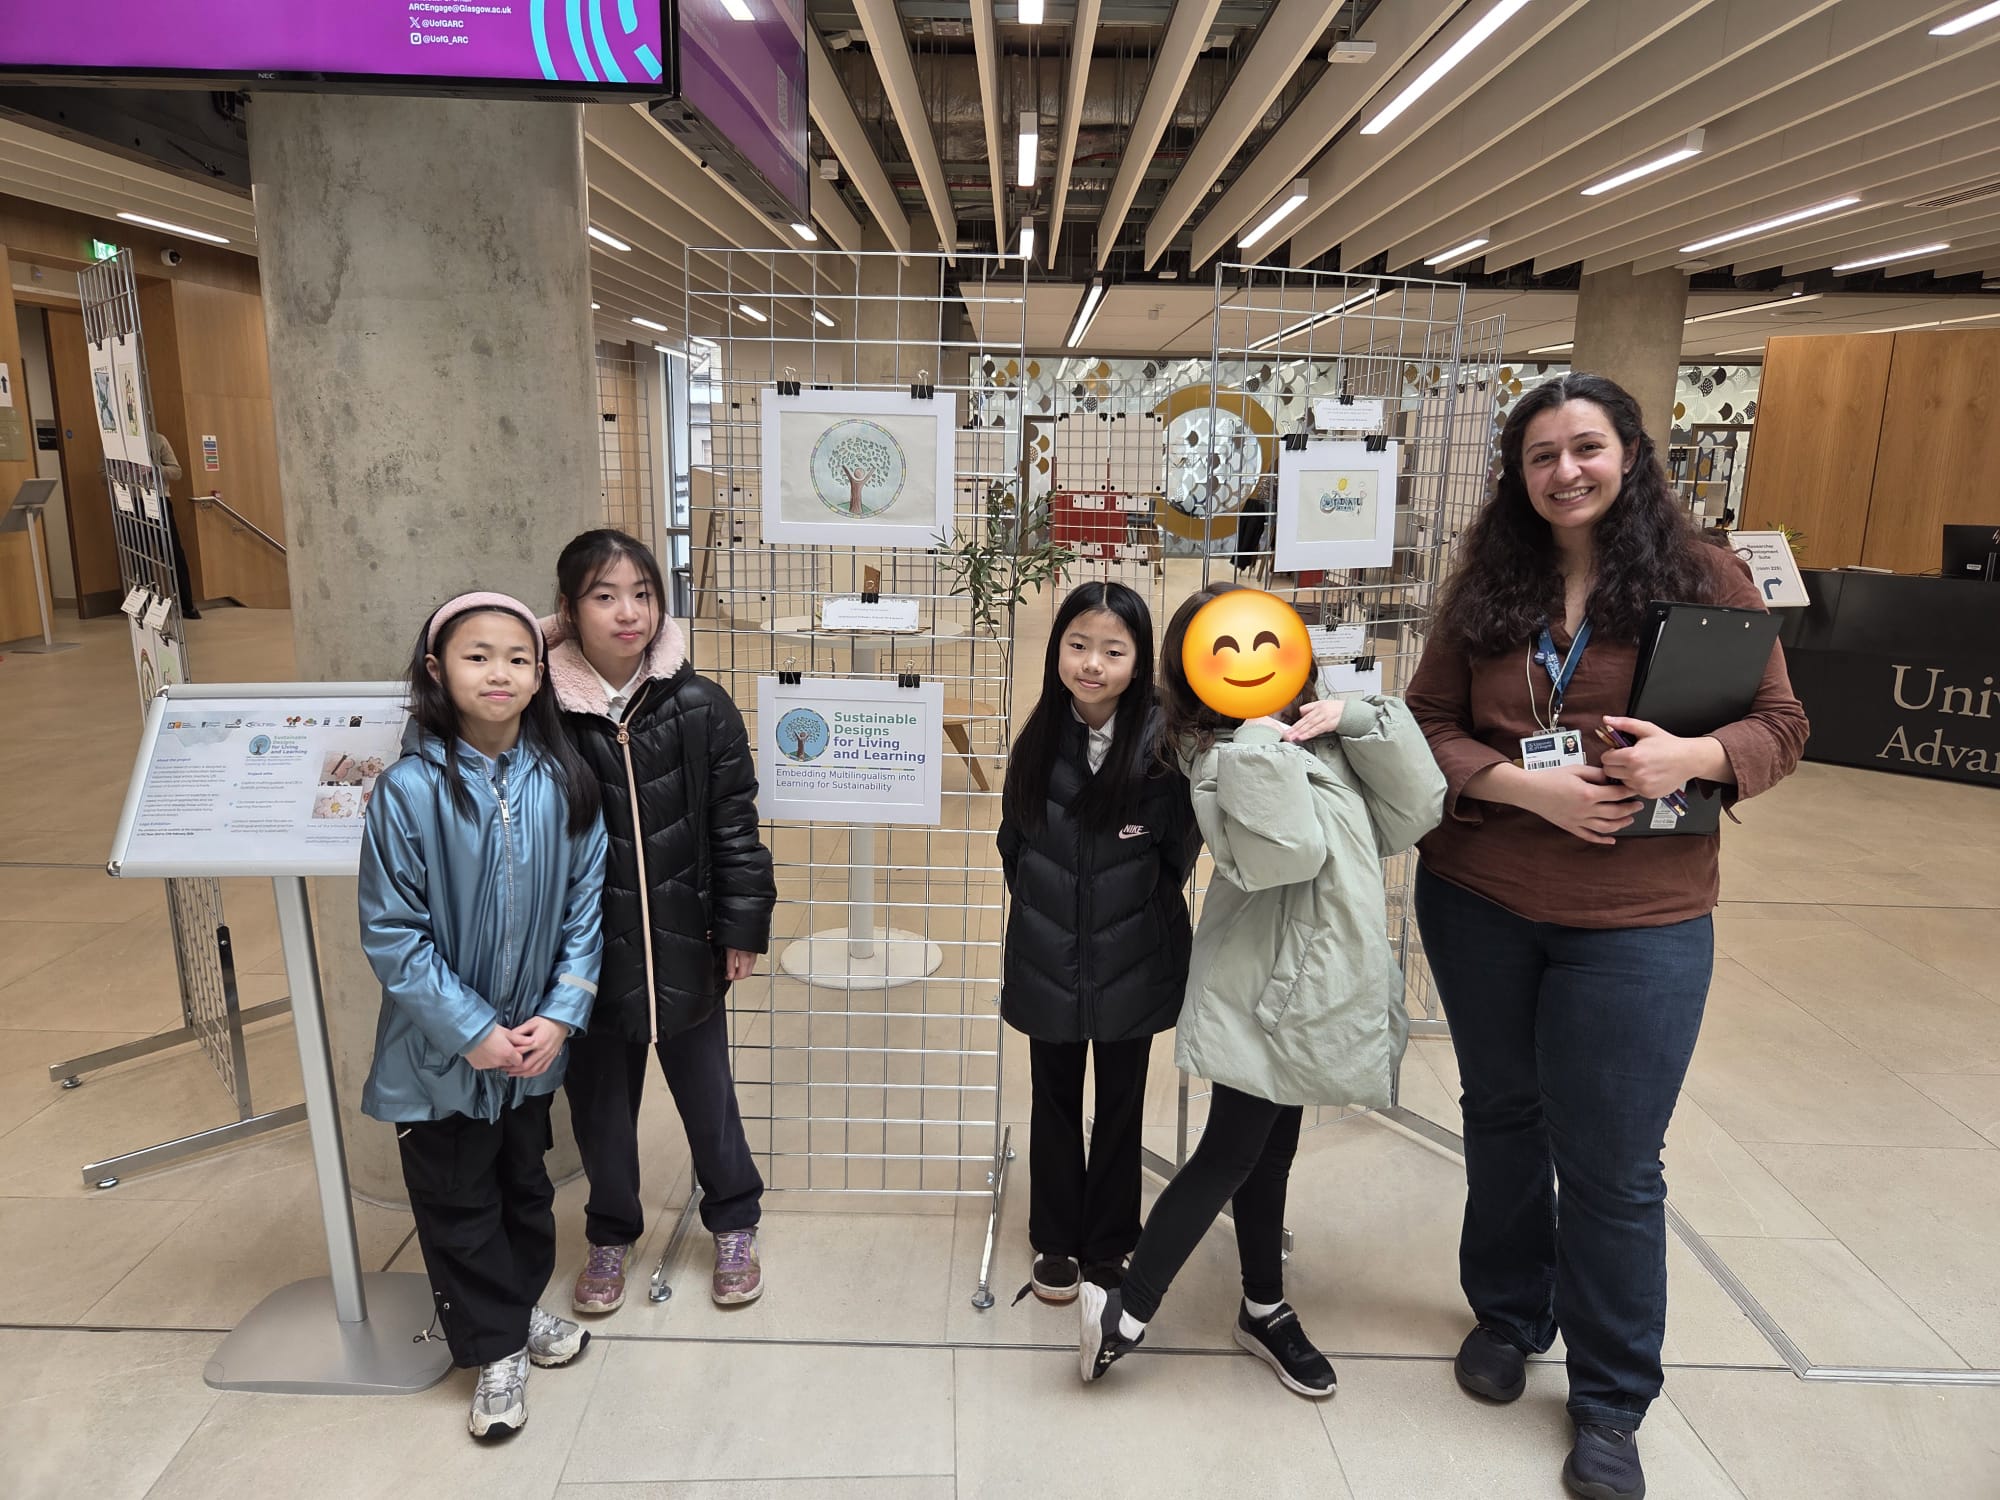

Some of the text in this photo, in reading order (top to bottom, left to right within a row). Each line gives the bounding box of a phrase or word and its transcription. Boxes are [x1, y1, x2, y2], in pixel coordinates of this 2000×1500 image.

[408, 2, 512, 15] ARCEngage@Glasgow.ac.uk
[421, 19, 464, 28] @UofGARC
[422, 35, 469, 45] @UofG_ARC
[257, 72, 276, 80] NEC
[1891, 664, 2000, 719] Uni
[834, 711, 917, 725] Sustainable
[834, 724, 890, 738] Designs
[833, 736, 900, 751] for Living
[833, 749, 926, 764] and Learning
[776, 768, 916, 782] Embedding Multilingualism into
[776, 779, 892, 793] Learning for Sustainability
[1123, 824, 1144, 833] NIKE
